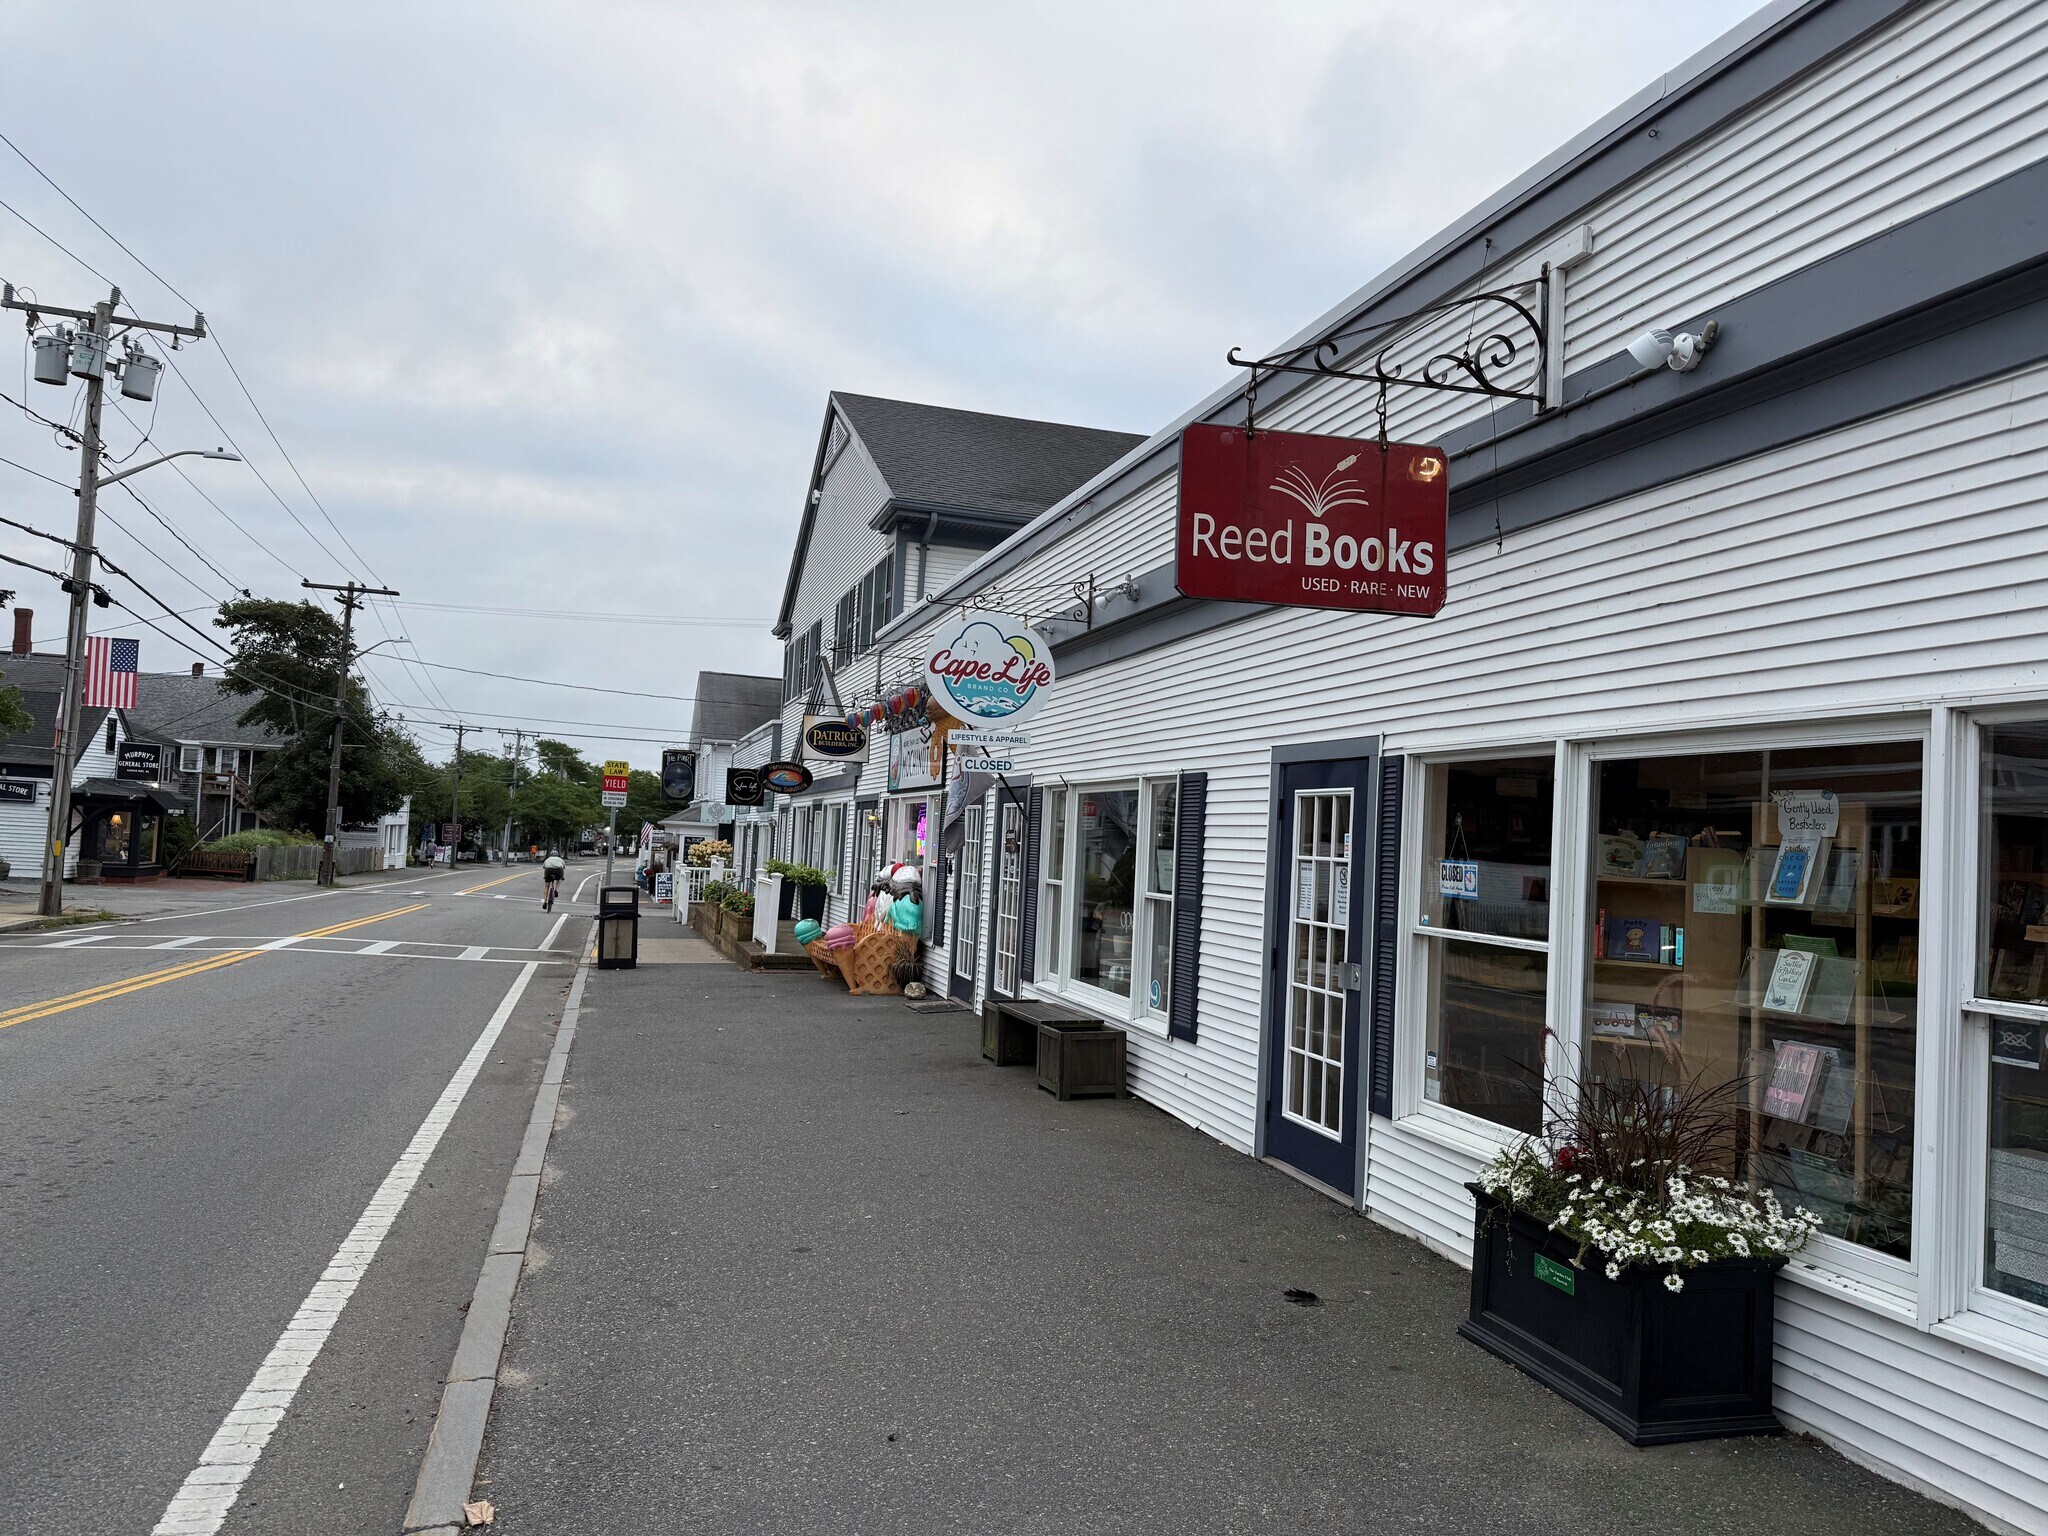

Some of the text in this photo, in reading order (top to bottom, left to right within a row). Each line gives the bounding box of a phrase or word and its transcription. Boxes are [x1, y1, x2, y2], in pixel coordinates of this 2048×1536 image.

[1192, 512, 1434, 576] Reed Books
[1301, 576, 1431, 599] USED RARE NEW
[929, 649, 1051, 695] Cape Life
[967, 683, 1011, 694] BRAND CO.
[813, 729, 860, 746] PATRIOT
[951, 733, 1028, 744] LIFESTYLE & APPAREL
[124, 751, 155, 761] MURPHY'S
[118, 760, 142, 768] GENERAL
[606, 761, 627, 769] STATE
[964, 759, 1012, 771] CLOSED
[8, 784, 29, 796] STORE
[604, 779, 627, 789] YIELD
[762, 779, 782, 792] Fitness
[783, 782, 808, 793] Solutions
[1783, 800, 1834, 819] Gently Used
[1788, 816, 1827, 831] Bestsellers
[1441, 864, 1464, 883] CLOSED
[1623, 919, 1648, 928] Potty
